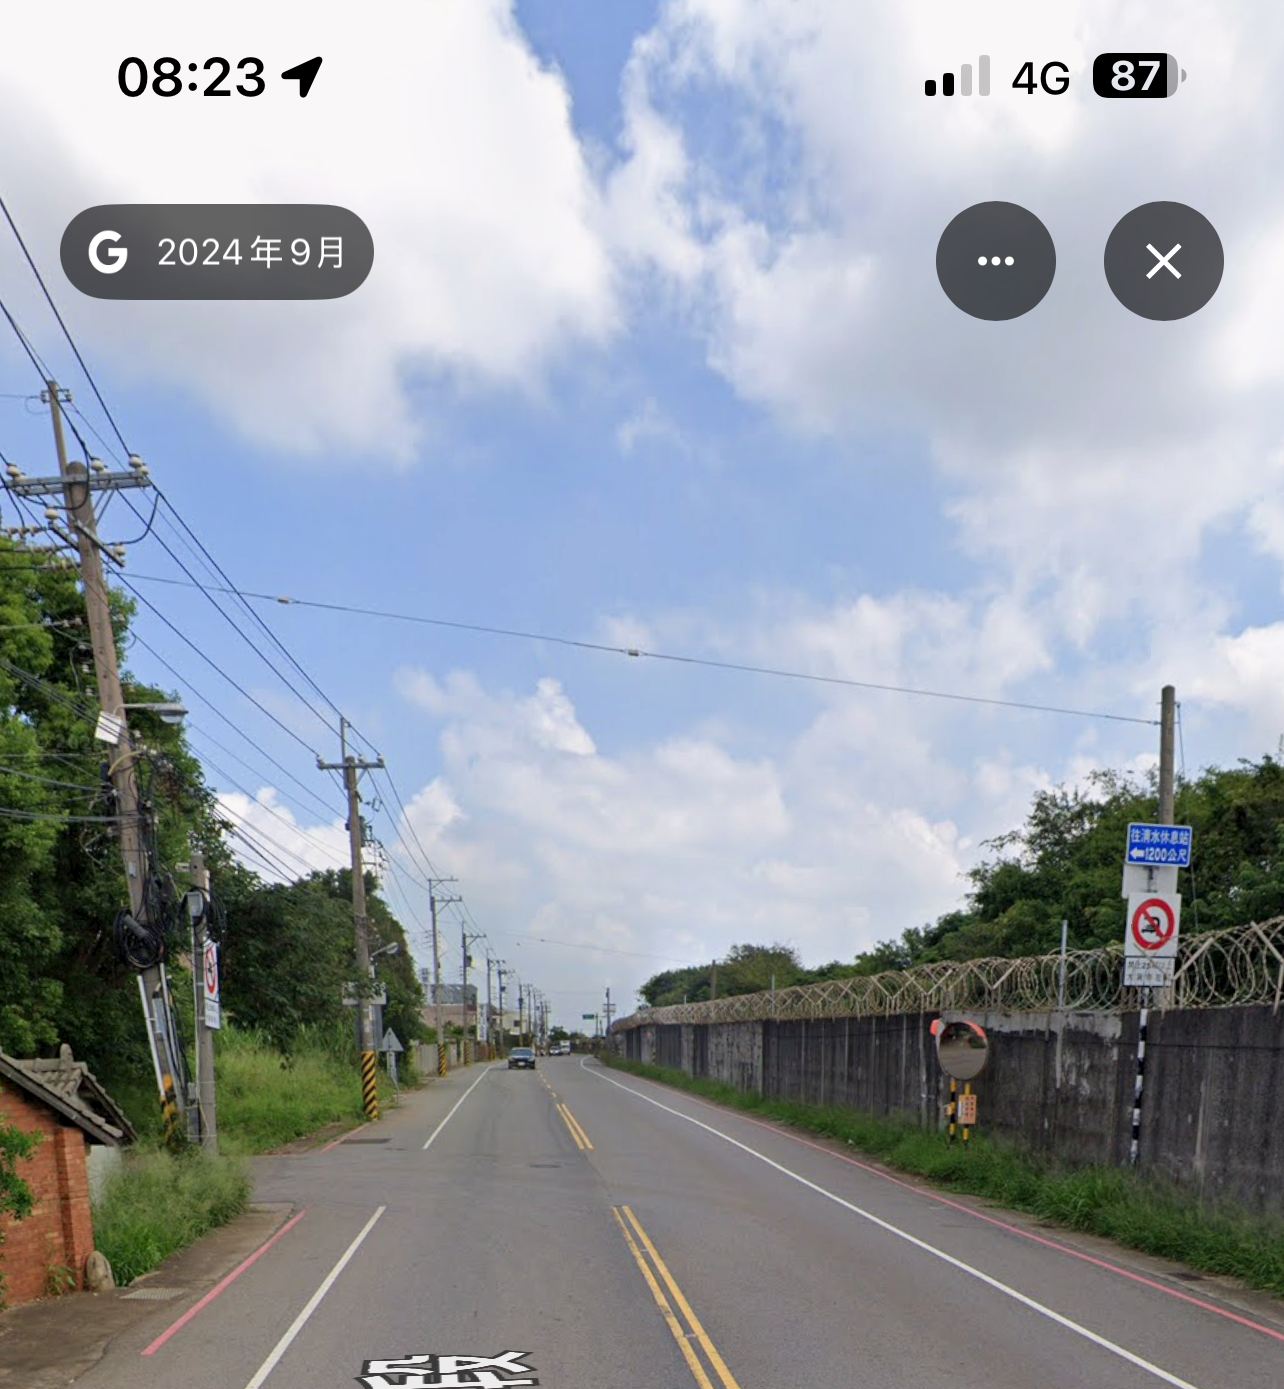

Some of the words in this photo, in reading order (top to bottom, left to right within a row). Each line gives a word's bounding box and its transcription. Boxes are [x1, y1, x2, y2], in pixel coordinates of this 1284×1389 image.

[1131, 828, 1190, 846] 往清水休息站
[1145, 847, 1188, 862] 1200公尺
